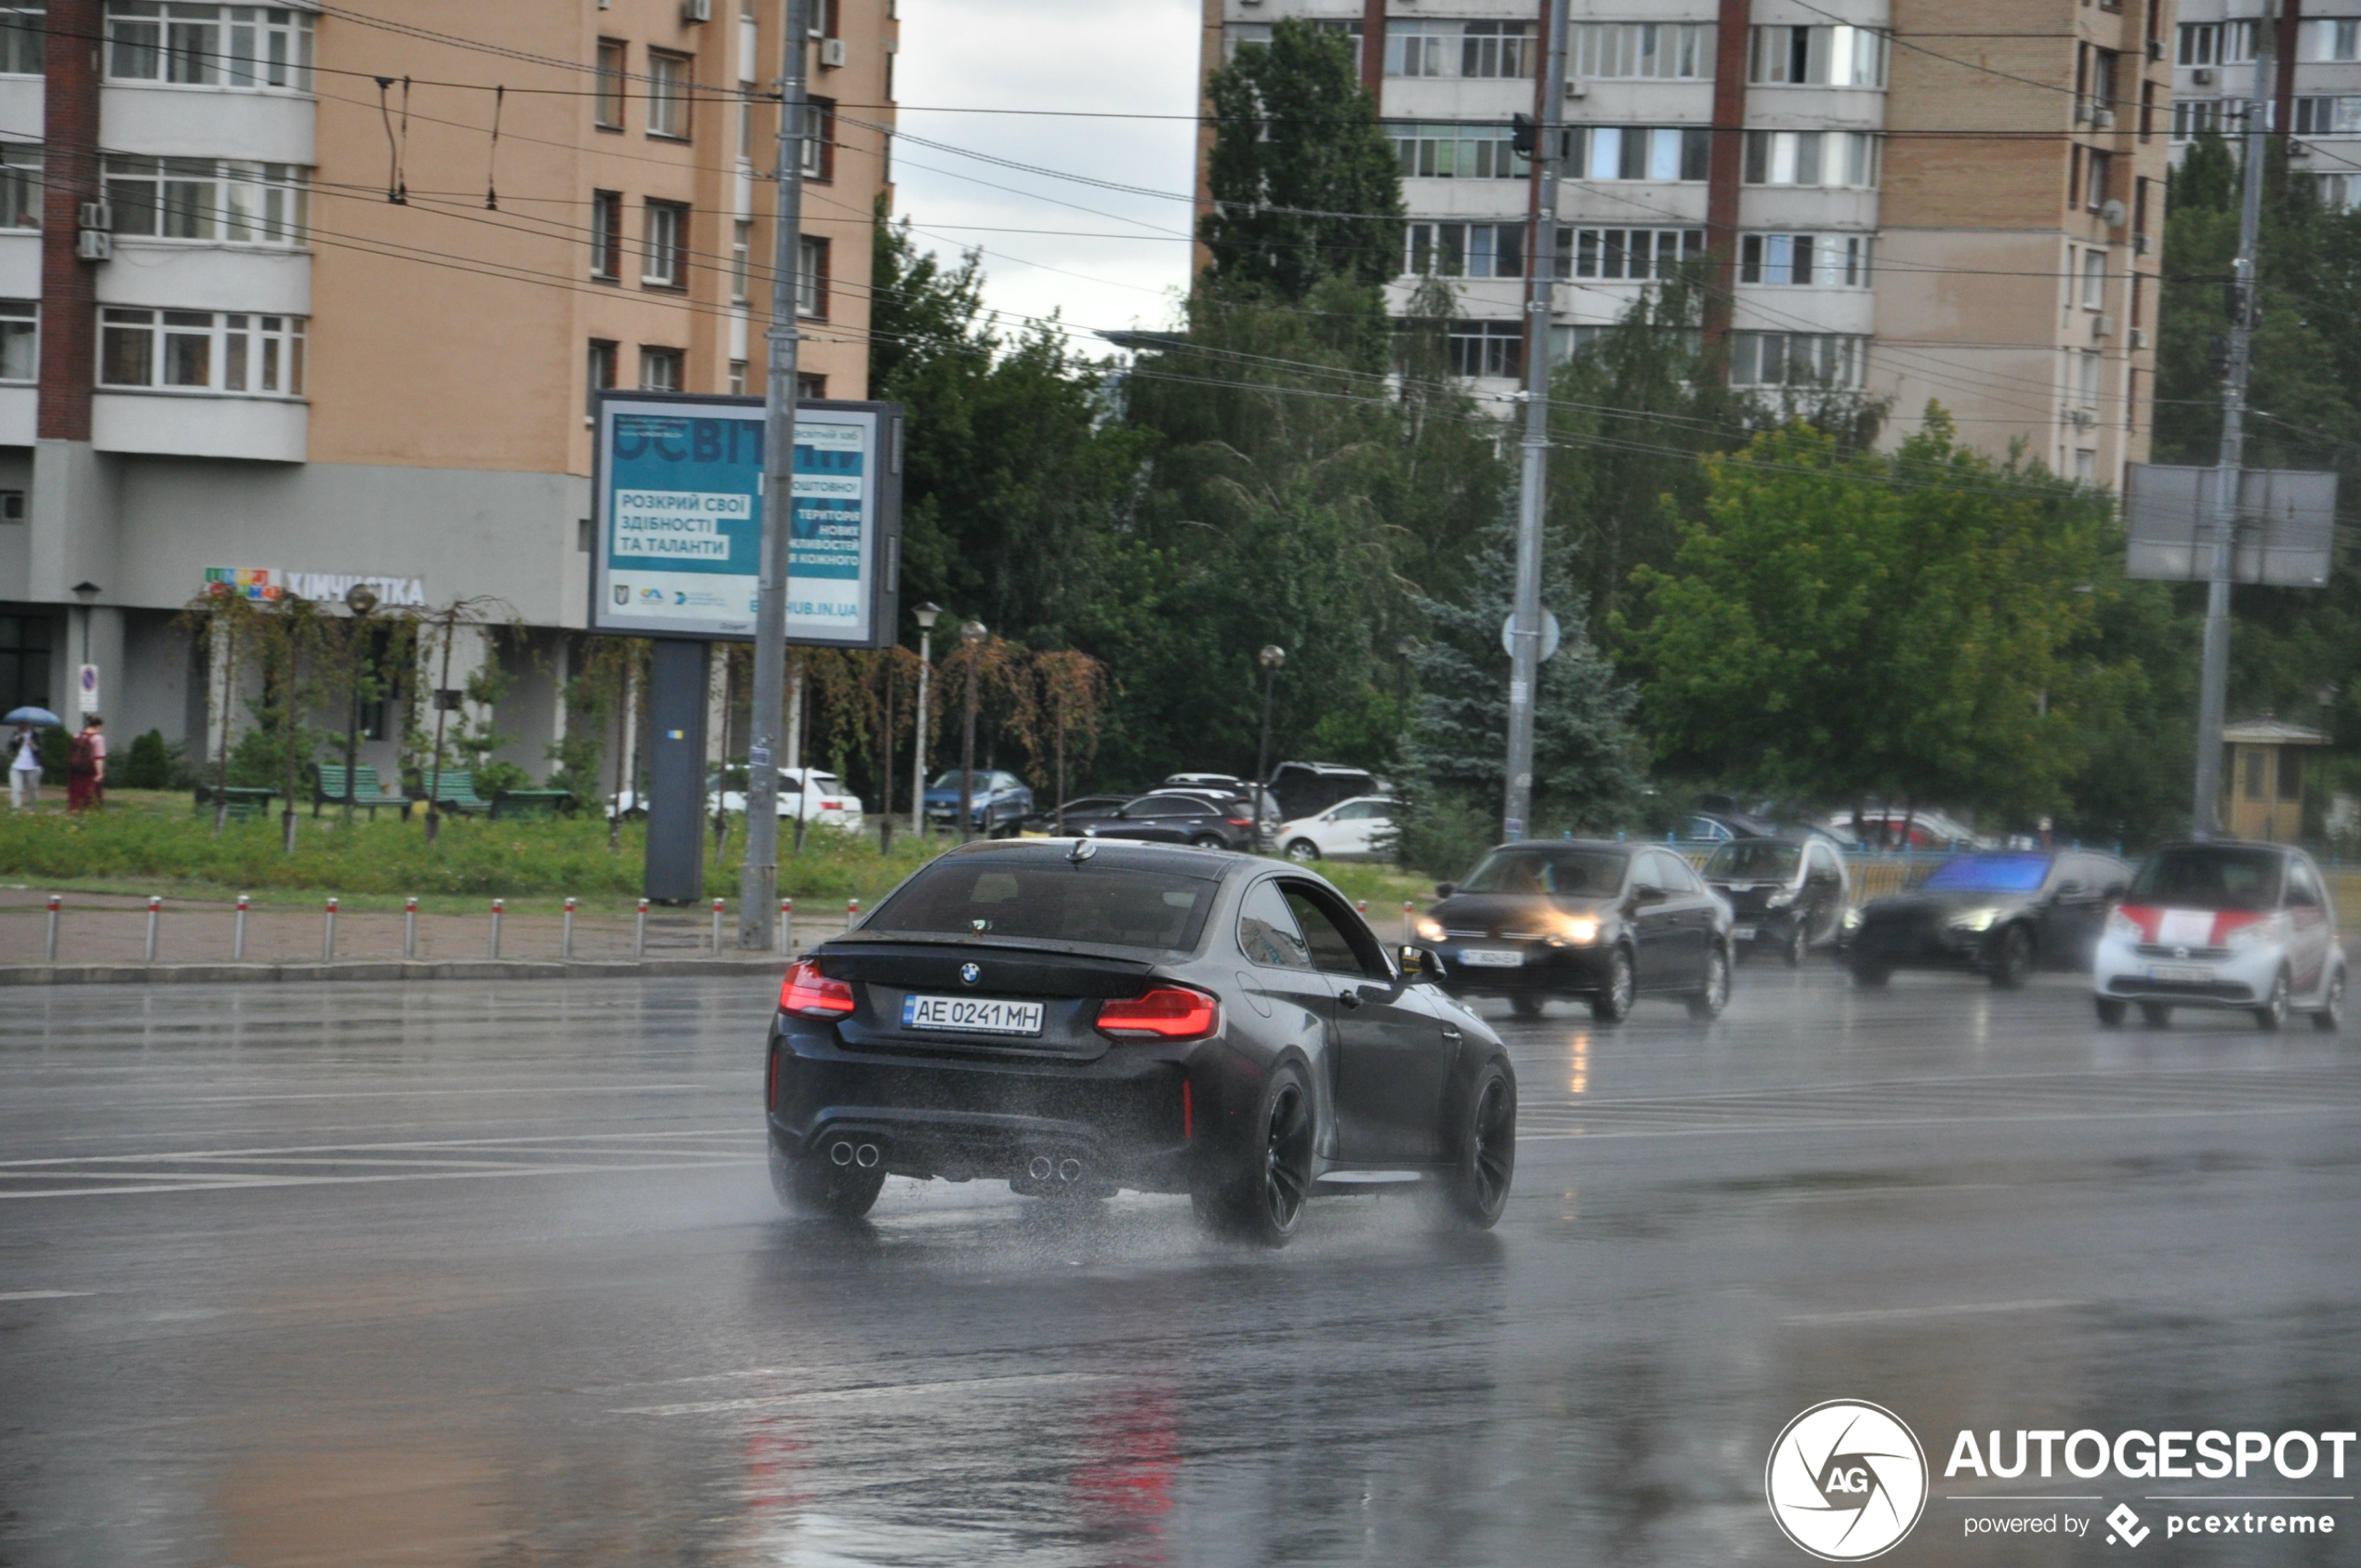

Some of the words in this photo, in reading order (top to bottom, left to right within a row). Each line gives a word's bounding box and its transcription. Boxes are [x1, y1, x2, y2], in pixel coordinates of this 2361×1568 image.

[793, 481, 858, 493] ОШТОВНО!
[622, 494, 700, 510] РОЗКРИЙ
[705, 495, 745, 512] СВОЇ
[621, 516, 711, 532] ЗДІБНОСТІ
[621, 537, 641, 551] ТА
[647, 538, 724, 554] ТАЛАНТИ
[799, 554, 860, 566] КОЖНОГО
[917, 1000, 947, 1022] AE
[952, 1003, 1001, 1025] 0241
[1006, 1006, 1039, 1028] MH
